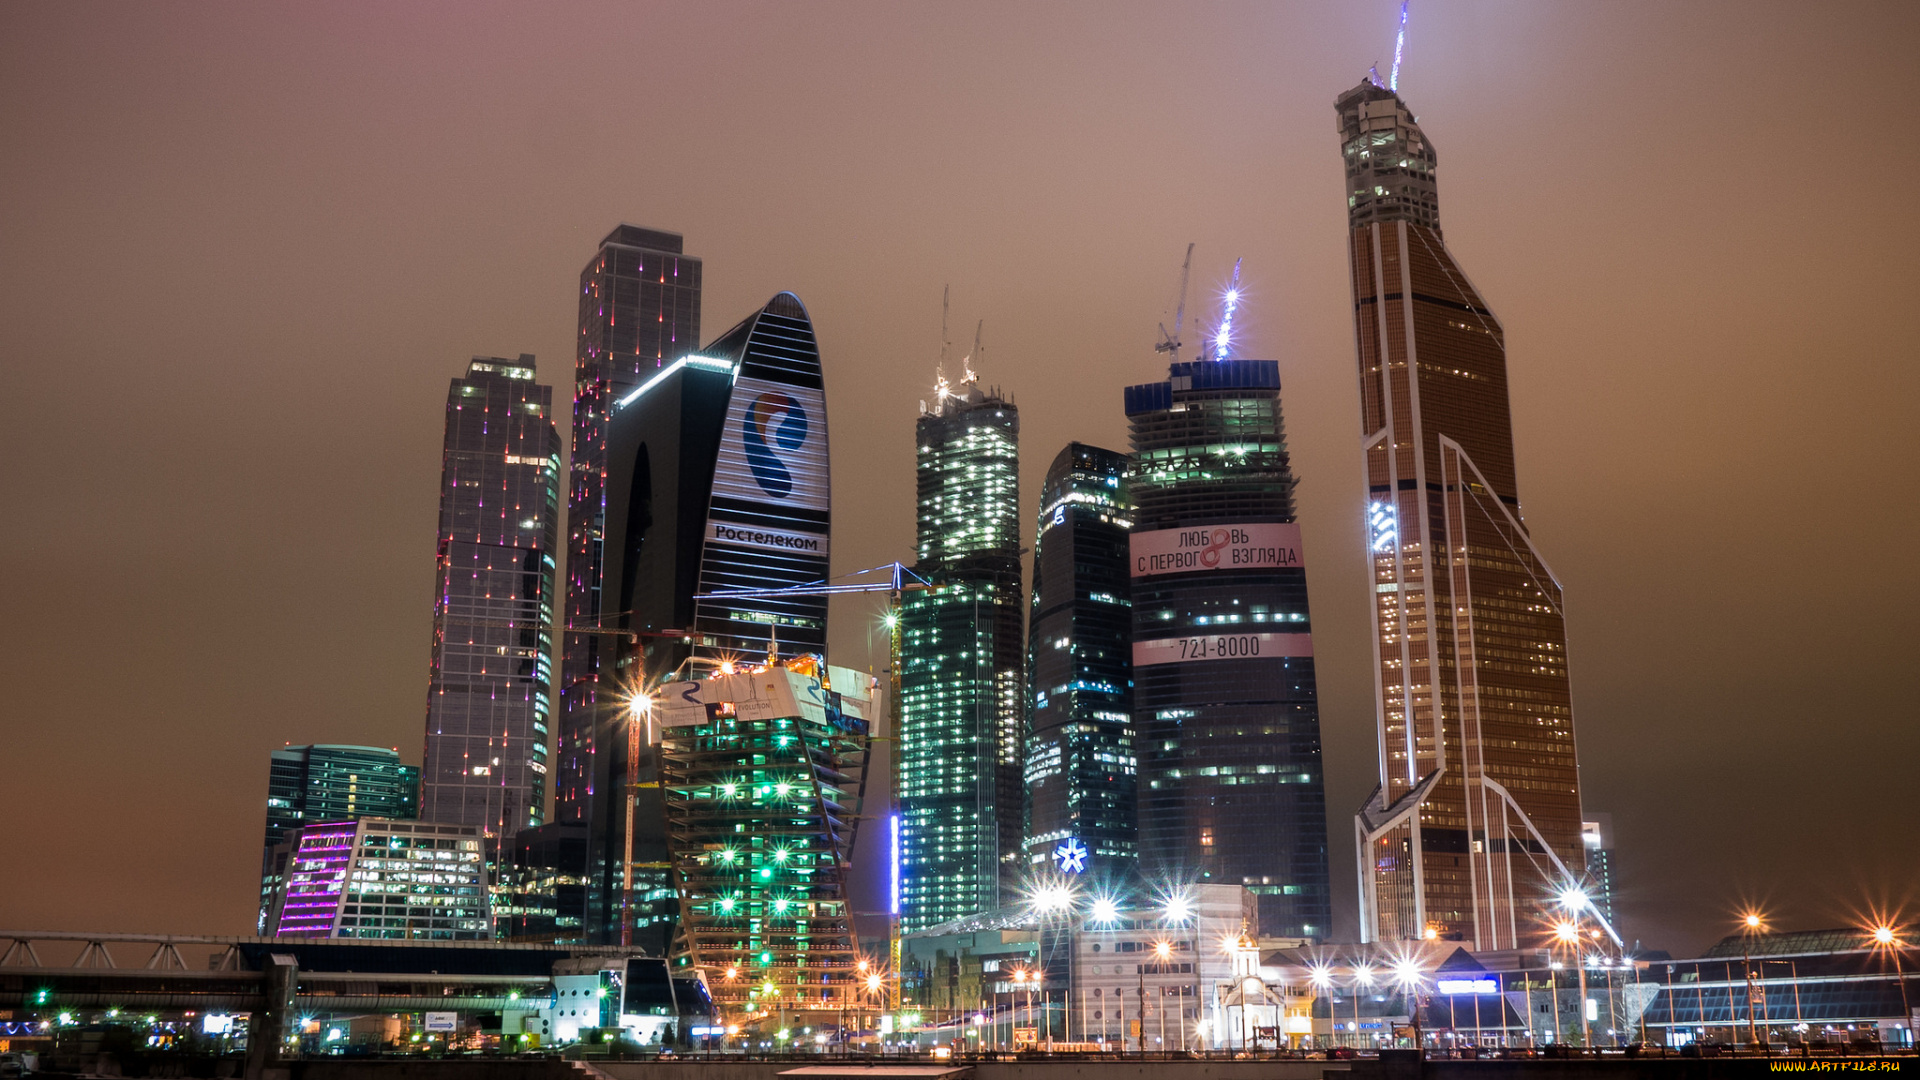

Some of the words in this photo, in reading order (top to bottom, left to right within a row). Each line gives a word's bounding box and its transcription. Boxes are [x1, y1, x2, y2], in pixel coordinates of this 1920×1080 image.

[715, 525, 818, 551] Ростелеком
[1138, 556, 1146, 572] С
[1232, 547, 1297, 566] ВЗГЛЯДА
[1179, 636, 1260, 659] 721-8000
